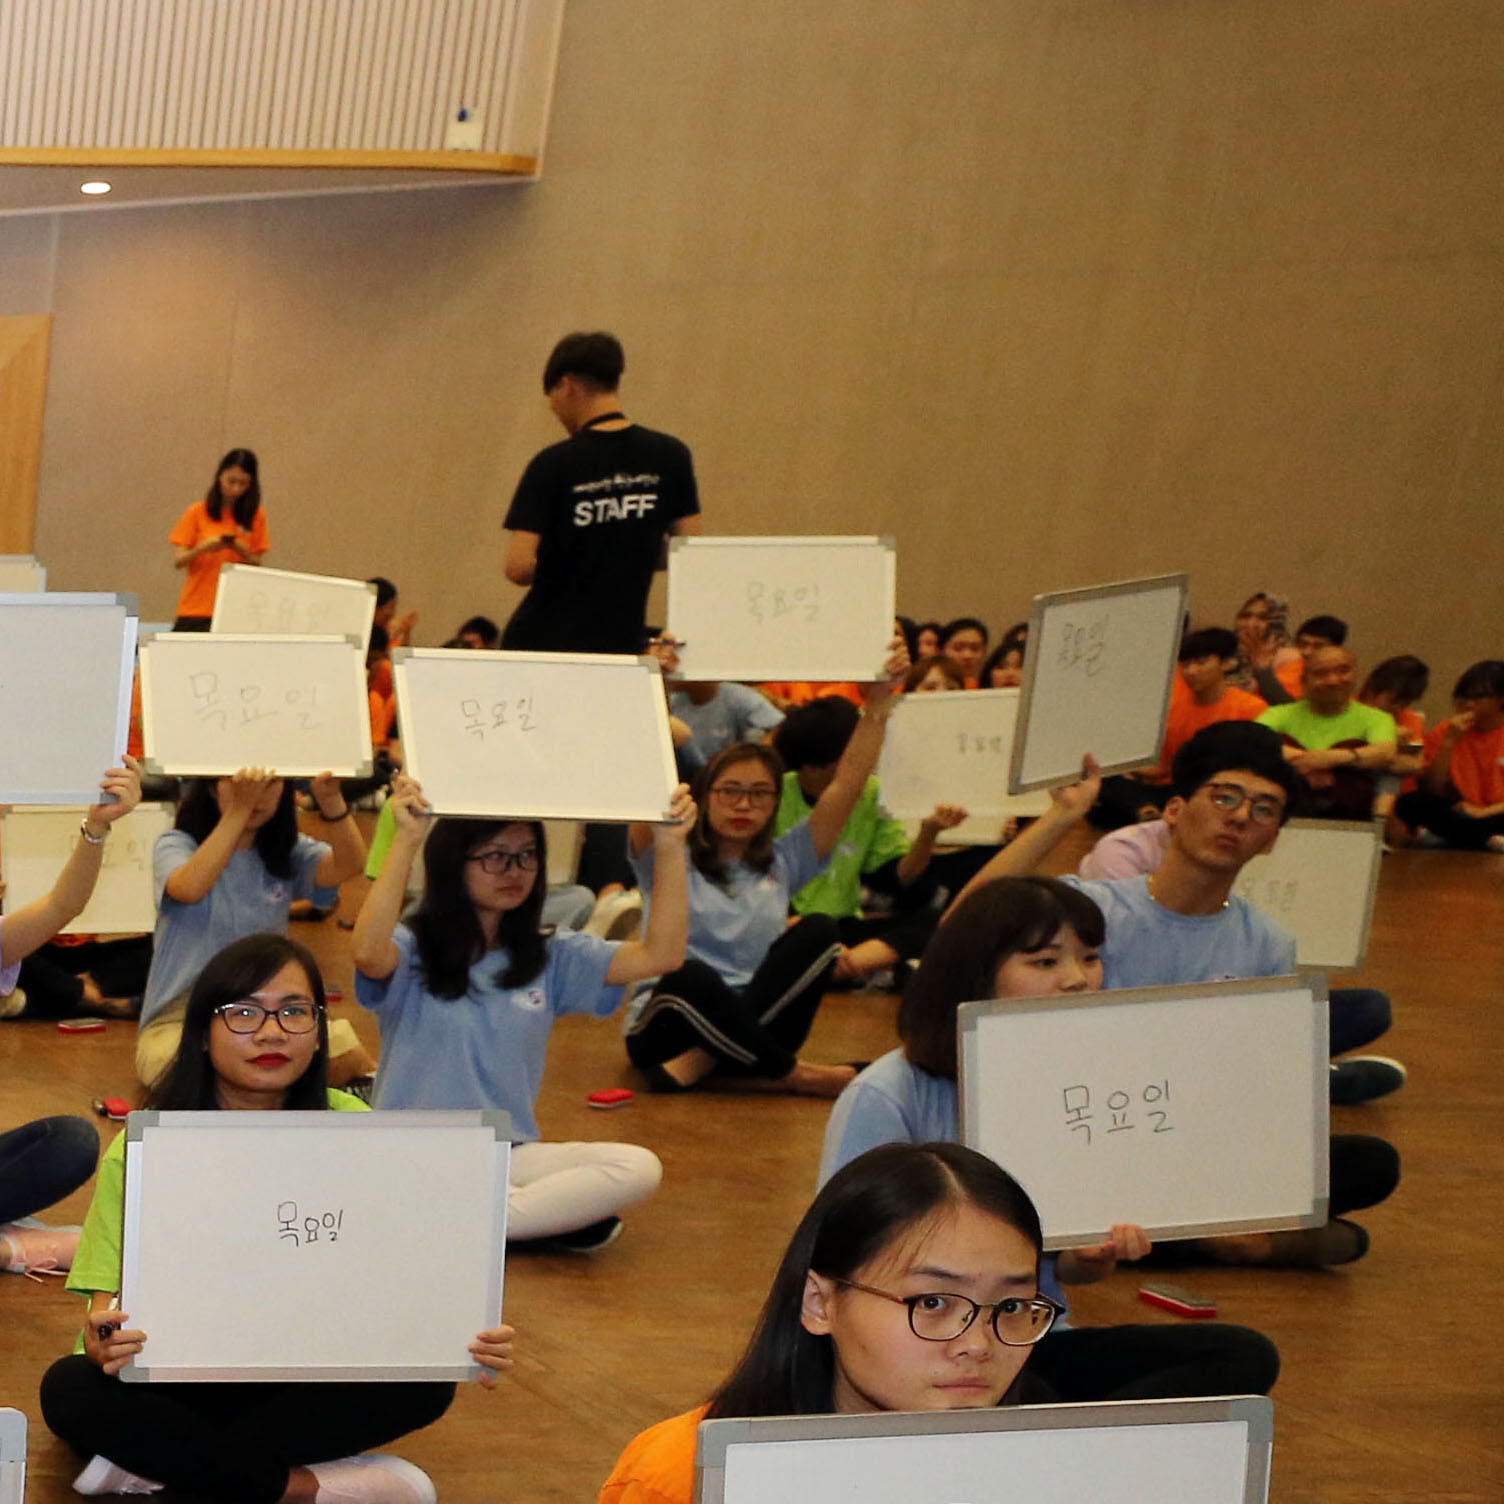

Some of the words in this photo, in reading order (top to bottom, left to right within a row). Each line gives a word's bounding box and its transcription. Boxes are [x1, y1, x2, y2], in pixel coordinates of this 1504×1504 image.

[573, 493, 659, 527] STAFF
[189, 671, 322, 733] 목요일
[460, 697, 537, 742] 목요일
[1063, 1079, 1174, 1145] 목요일
[277, 1201, 344, 1247] 목요일
